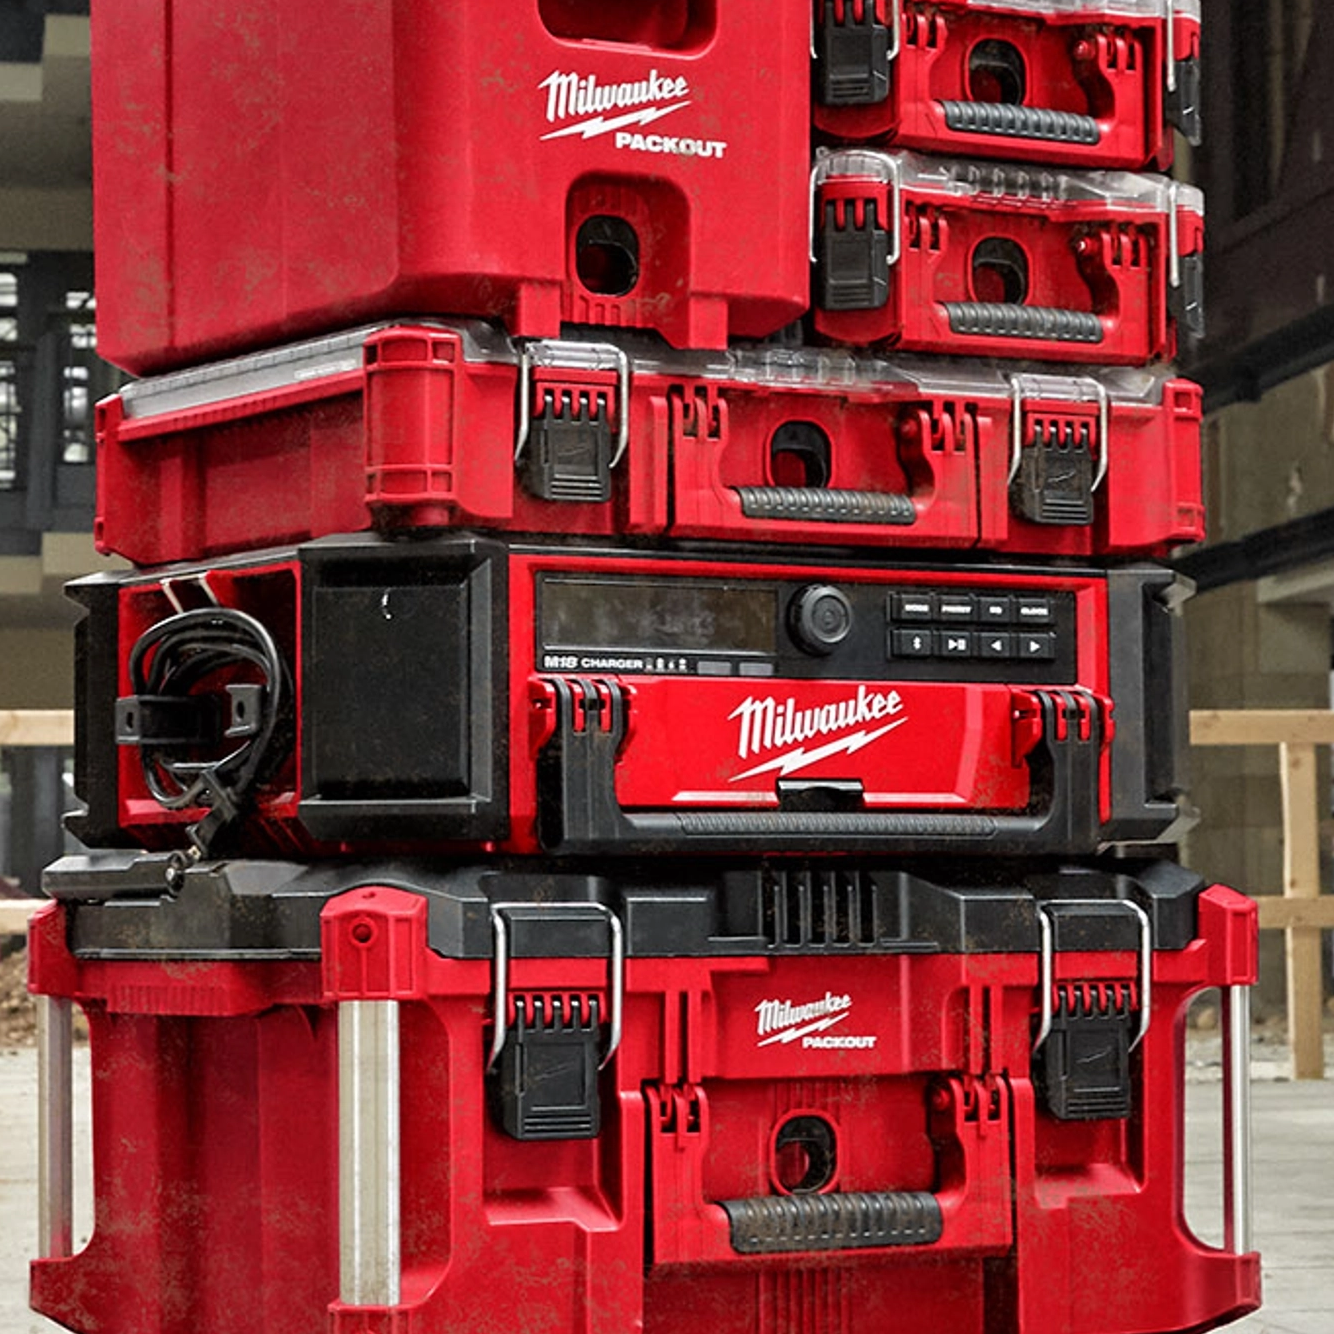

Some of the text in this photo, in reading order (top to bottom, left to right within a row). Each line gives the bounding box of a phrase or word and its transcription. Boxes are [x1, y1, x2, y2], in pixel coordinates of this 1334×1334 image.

[538, 69, 690, 122] Milwaukee
[615, 131, 727, 159] PACKOUT
[543, 655, 644, 670] M18 CHARGER
[728, 684, 904, 759] Milwaukee
[754, 991, 852, 1035] Milwaukee
[802, 1036, 877, 1049] PACKOUT
